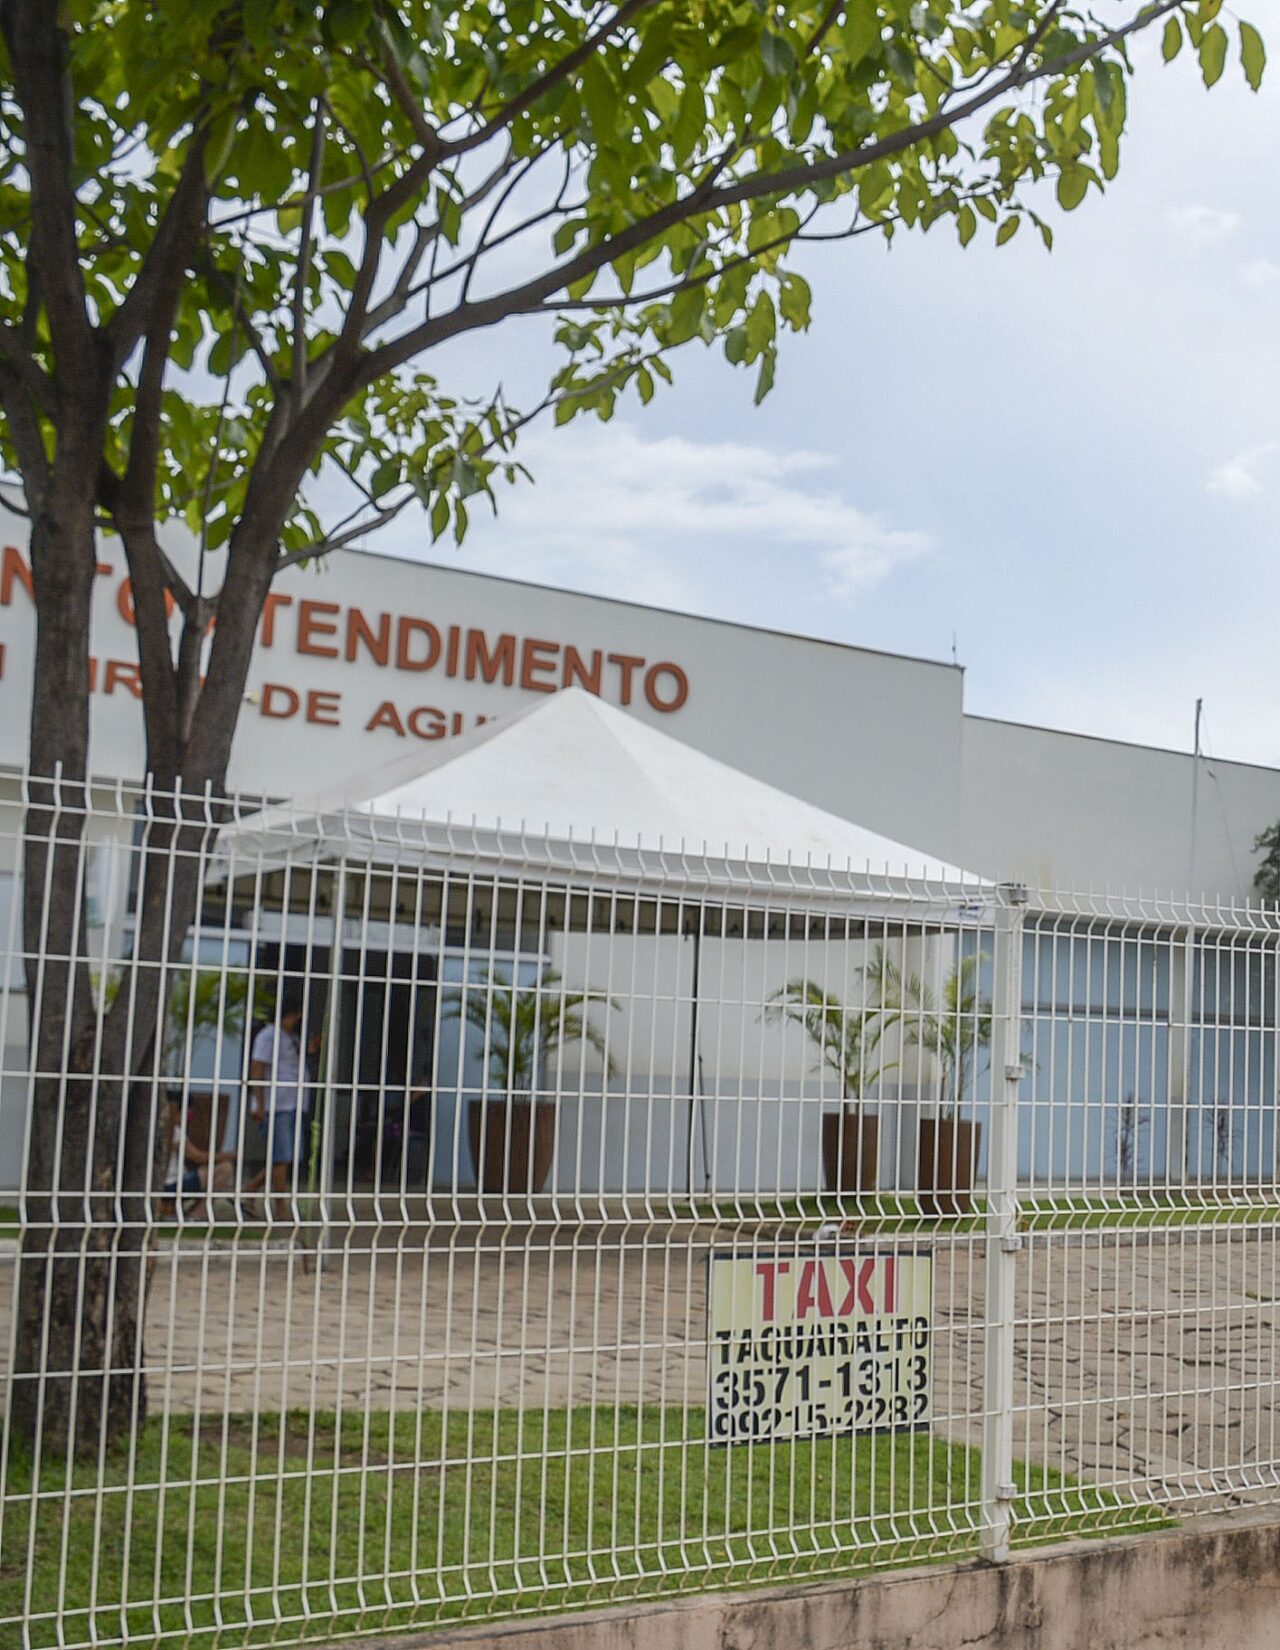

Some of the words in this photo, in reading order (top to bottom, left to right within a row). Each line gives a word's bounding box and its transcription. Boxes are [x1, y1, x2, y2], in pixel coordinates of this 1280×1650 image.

[205, 592, 690, 714] TENDIMENTO
[260, 683, 342, 727] DE
[756, 1256, 898, 1322] TAXI
[716, 1316, 928, 1365] TAQUARALTO
[716, 1355, 927, 1410] 3571-1313
